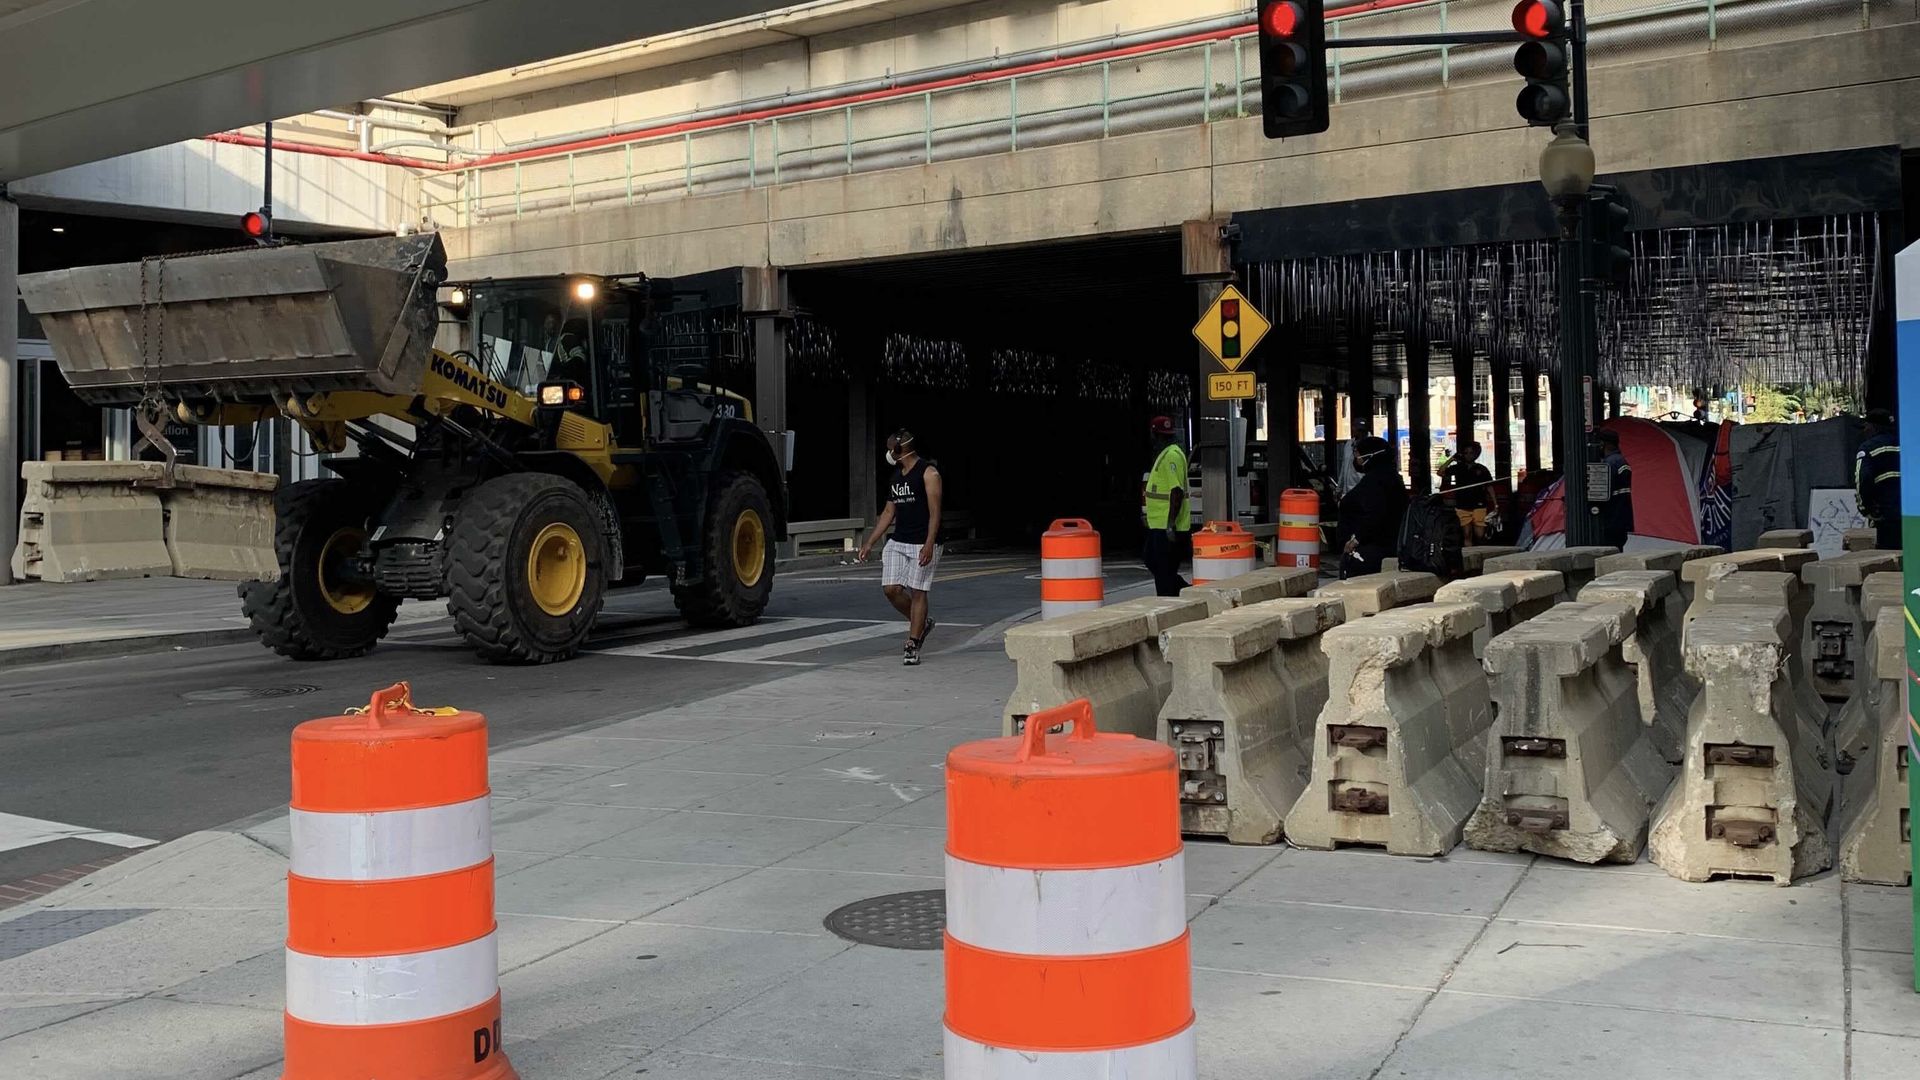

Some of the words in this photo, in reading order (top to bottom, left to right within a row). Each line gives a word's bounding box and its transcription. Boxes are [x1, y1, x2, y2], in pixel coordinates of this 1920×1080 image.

[431, 354, 507, 409] KOMATSU
[1215, 381, 1232, 392] 150
[1237, 381, 1248, 390] FT
[891, 482, 914, 497] Nah.
